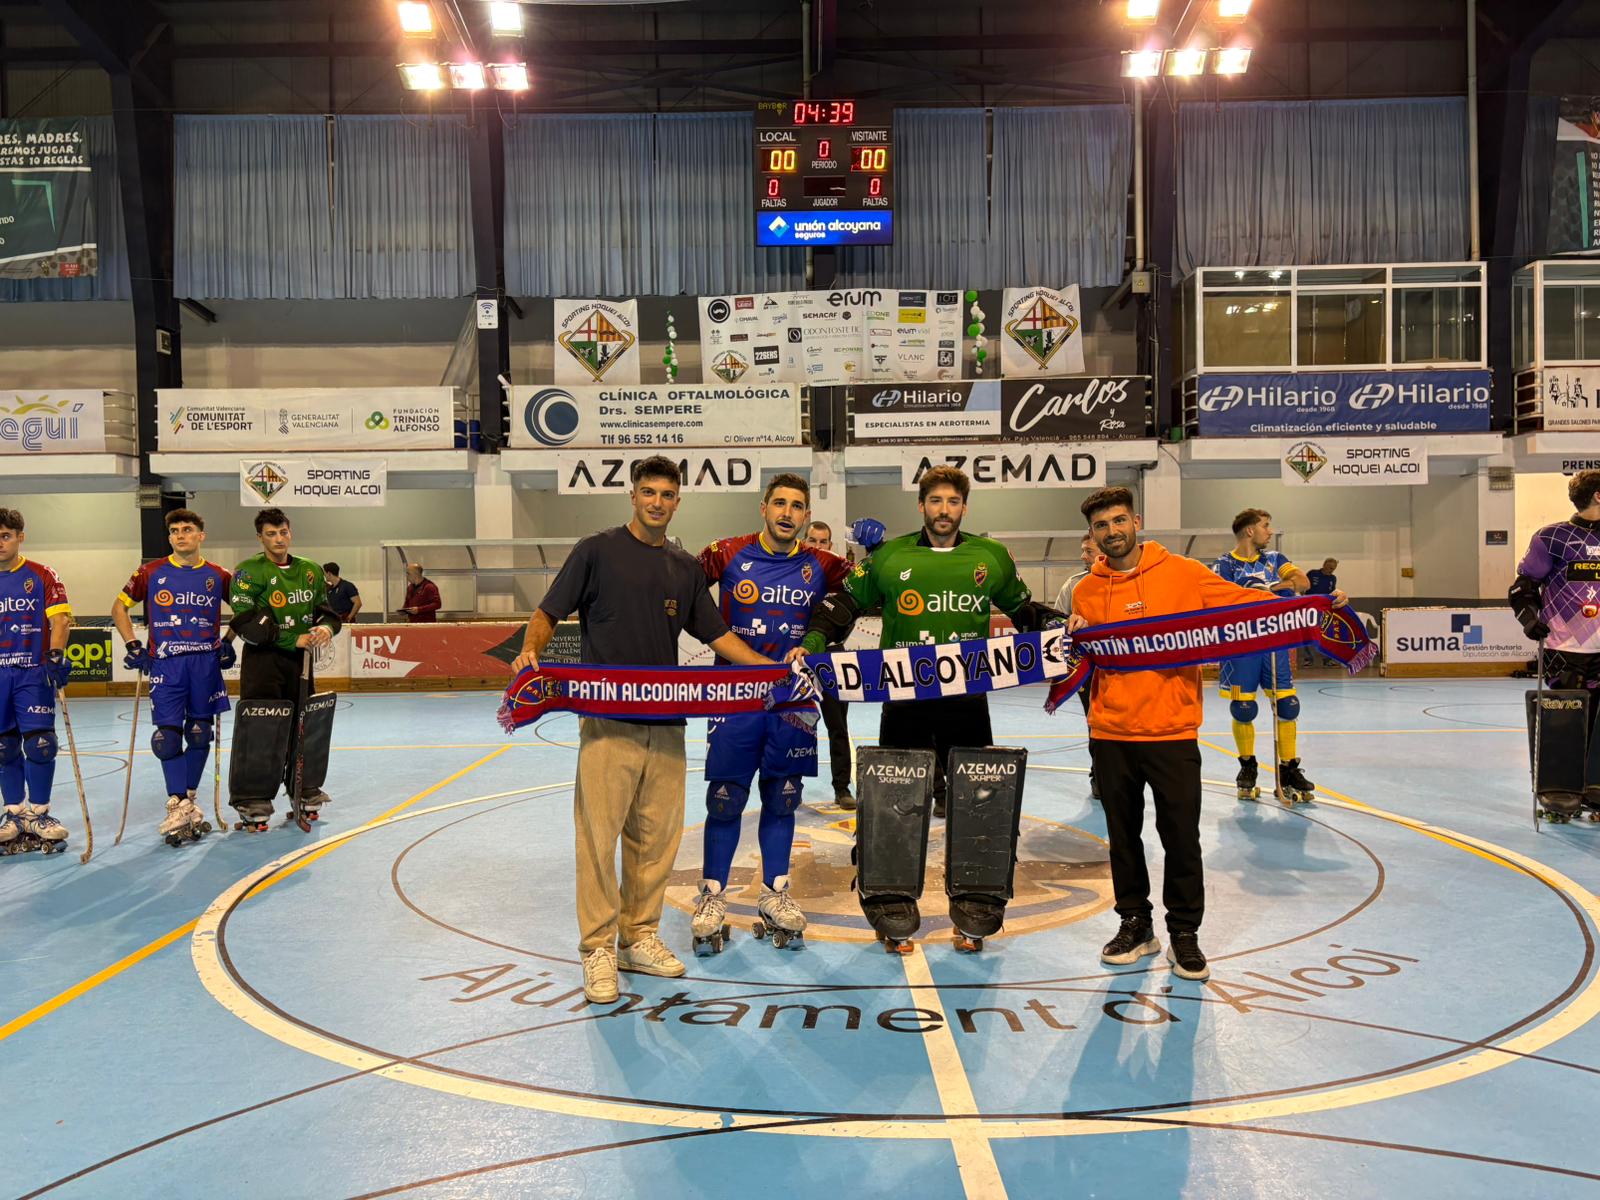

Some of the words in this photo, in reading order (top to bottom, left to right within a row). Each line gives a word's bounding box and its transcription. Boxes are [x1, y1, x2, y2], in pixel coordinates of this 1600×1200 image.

[794, 102, 854, 123] 04:39
[760, 132, 796, 142] LOCAL
[851, 131, 887, 141] VISITANTE
[38, 145, 74, 154] JUGAR
[819, 141, 829, 157] 0
[29, 156, 40, 165] 10
[43, 155, 83, 165] REGLAS
[770, 150, 796, 170] 00
[860, 149, 886, 169] 00
[768, 179, 779, 196] 0
[870, 178, 881, 195] 0
[761, 199, 787, 207] FALTAS
[862, 198, 888, 206] FALTAS
[794, 219, 826, 231] unión
[828, 219, 881, 234] alcoyana
[794, 231, 826, 240] seguros
[827, 290, 881, 307] erum
[1007, 291, 1035, 318] SPORTING
[561, 304, 590, 329] SPORTING
[591, 303, 618, 316] HOQUEI
[599, 388, 658, 401] CLÍNICA
[667, 386, 790, 400] OFTALMOLÓGICA
[904, 389, 962, 404] Hilario
[1247, 386, 1337, 406] Hilario
[1398, 383, 1489, 404] Hilario
[599, 406, 627, 415] Drs.
[634, 405, 703, 415] SEMPERE
[1009, 378, 1130, 432] Carlos
[187, 413, 246, 421] COMUNITAT
[1109, 408, 1116, 417] y
[191, 422, 205, 430] DE
[207, 422, 253, 430] L'ESPORT
[393, 416, 440, 424] TRINIDAD
[600, 420, 703, 429] www.clinicasempere.com
[1099, 418, 1126, 431] Rosa
[393, 424, 440, 432] ALFONSO
[1250, 423, 1323, 433] Climatización
[1325, 422, 1373, 432] eficiente
[1375, 424, 1382, 432] y
[1384, 421, 1437, 430] saludable
[618, 435, 631, 444] 96
[634, 434, 653, 444] 552
[656, 434, 668, 444] 14
[671, 434, 684, 443] 16
[733, 434, 754, 443] Oliver
[775, 433, 795, 443] Alcoy
[1346, 448, 1410, 459] SPORTING
[307, 470, 371, 480] SPORTING
[568, 458, 752, 488] AZAD
[1332, 464, 1381, 475] HOQUEI
[1384, 463, 1420, 474] ALCOI
[294, 485, 342, 496] HOQUEI
[344, 485, 381, 495] ALCOI
[175, 591, 214, 607] aitex
[761, 585, 814, 606] aitex
[927, 590, 984, 612] aitex
[731, 625, 756, 636] suma
[1080, 635, 1130, 656] PATÍN
[1132, 625, 1220, 653] ALCODIAM
[1224, 607, 1318, 642] SALESIANO
[352, 635, 401, 654] UPV
[1396, 636, 1460, 651] suma
[64, 640, 112, 668] op!
[363, 658, 390, 669] Alcoi
[815, 662, 871, 690] C.D.
[877, 643, 1036, 690] ALCOYANO
[568, 678, 617, 701] PATÍN
[622, 682, 702, 702] ALCODIAM
[706, 681, 773, 701] SALESIA
[242, 707, 291, 716] AZEMAD
[866, 765, 927, 778] AZEMAD
[956, 763, 1017, 775] AZEMAD
